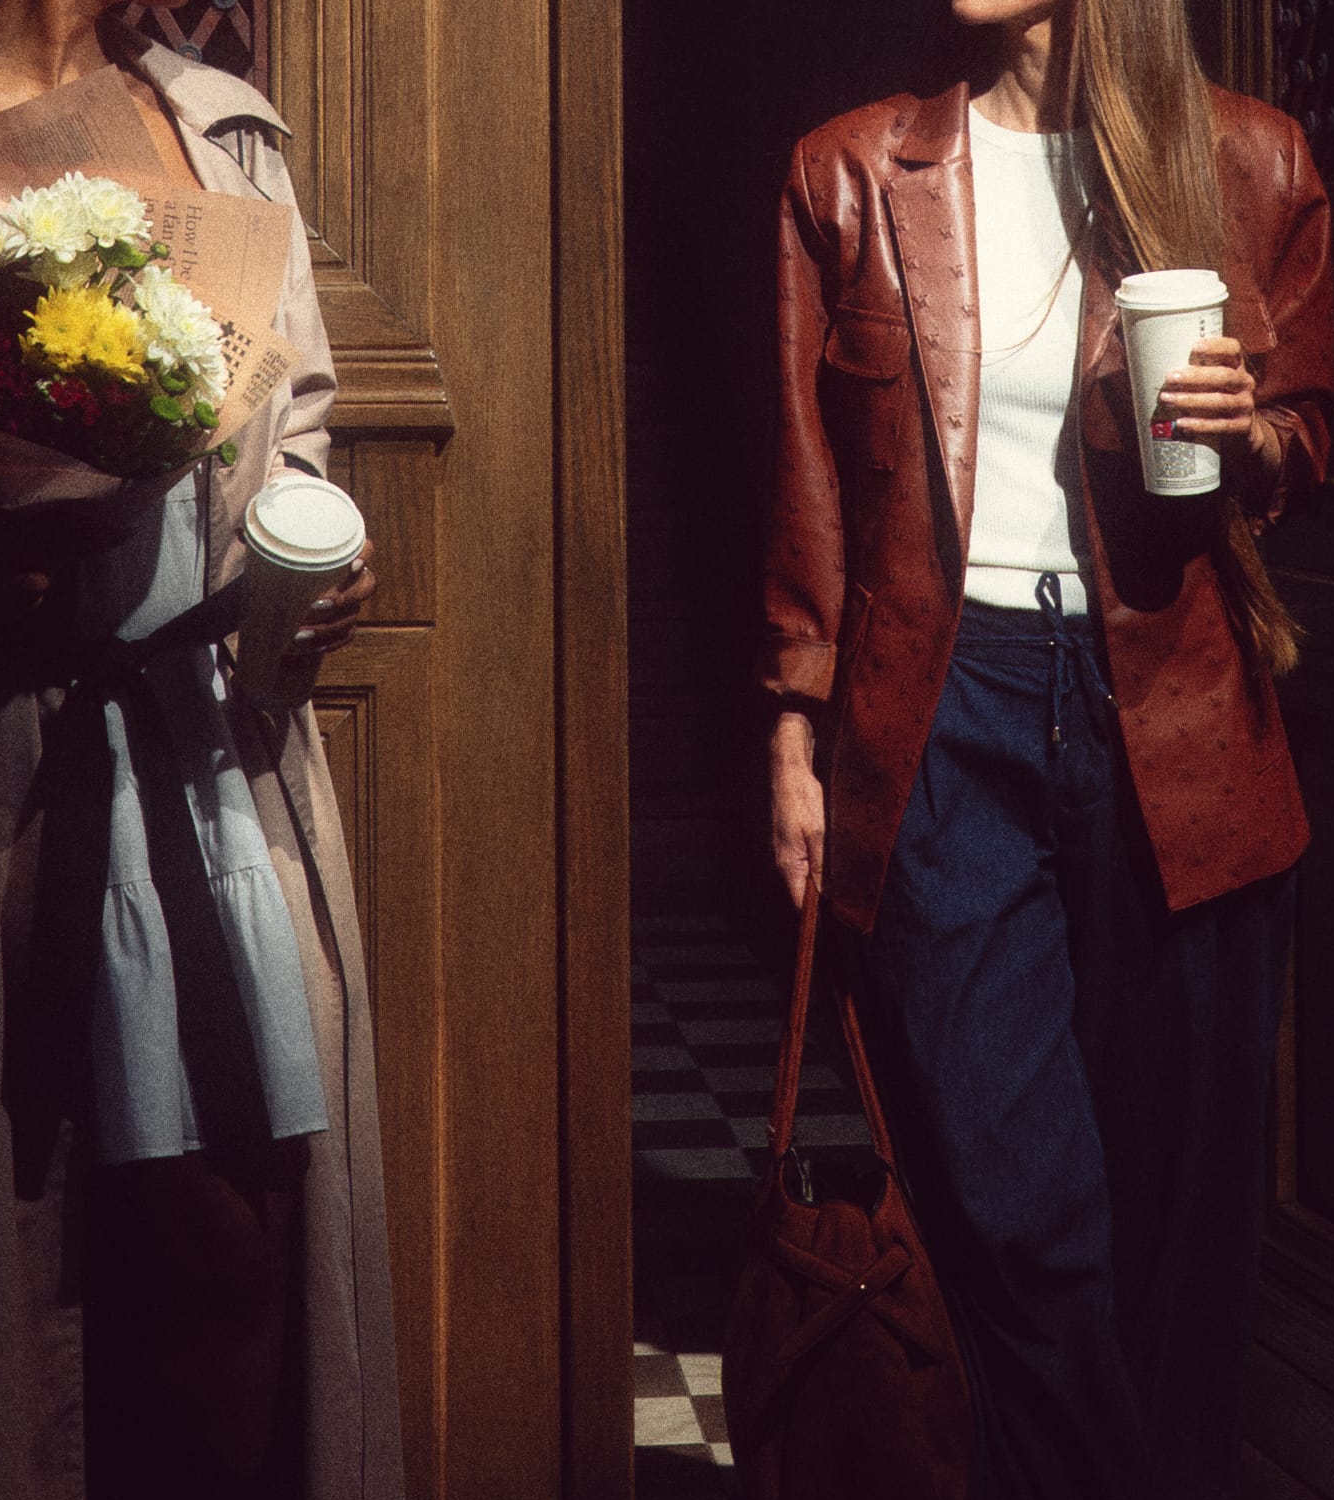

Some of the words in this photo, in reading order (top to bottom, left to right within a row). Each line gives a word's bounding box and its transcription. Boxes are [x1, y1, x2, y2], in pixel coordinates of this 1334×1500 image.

[164, 200, 176, 210] a
[162, 214, 181, 240] fan
[184, 204, 203, 246] How
